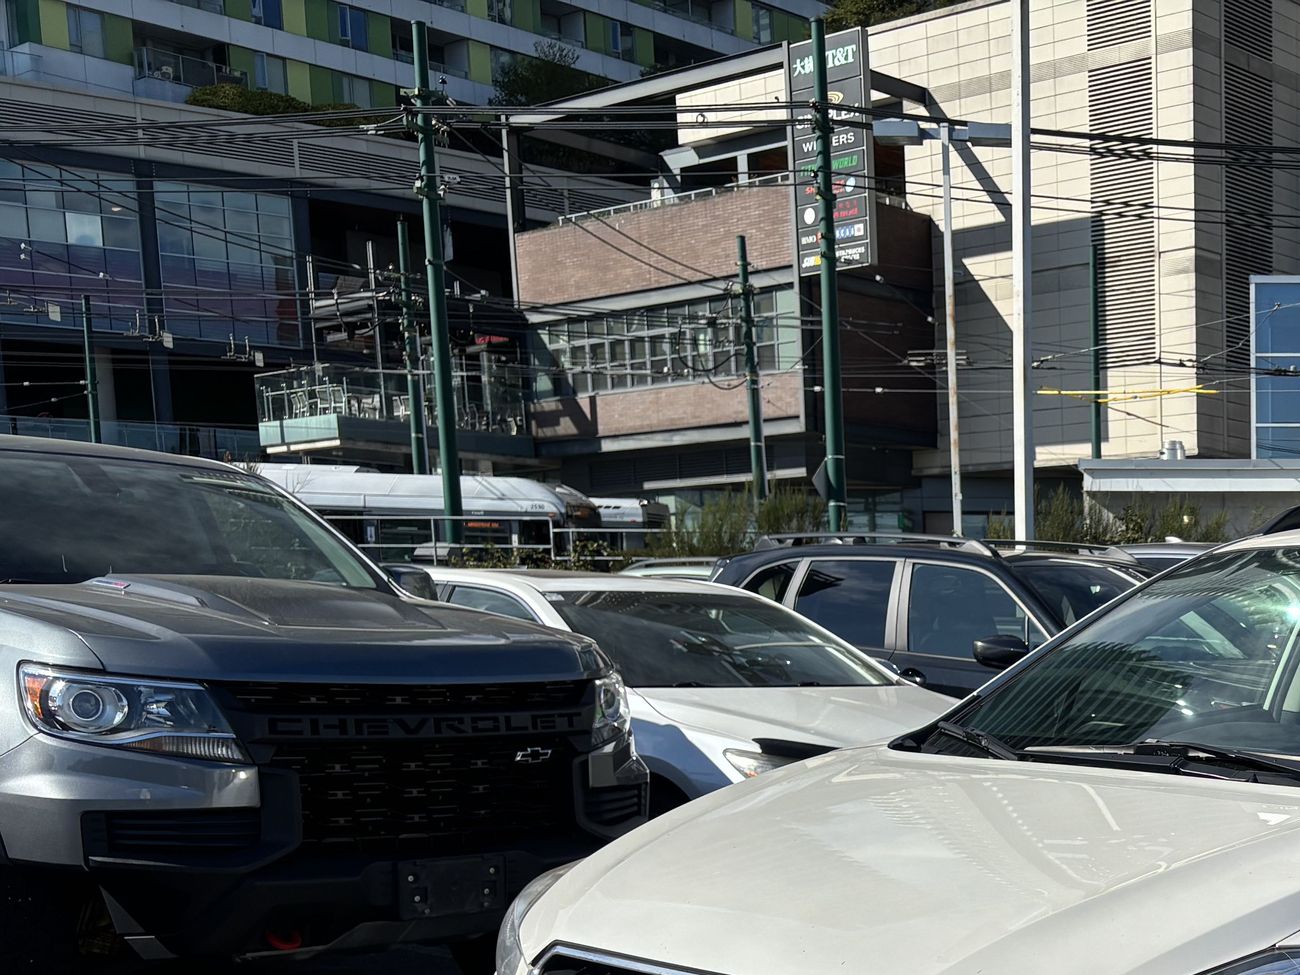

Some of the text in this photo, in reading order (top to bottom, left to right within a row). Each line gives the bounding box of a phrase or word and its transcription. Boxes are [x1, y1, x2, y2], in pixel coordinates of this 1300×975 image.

[825, 44, 857, 69] T&T
[802, 132, 855, 153] WIERS
[831, 155, 858, 170] WORLD
[267, 711, 583, 737] CHEVROLET
